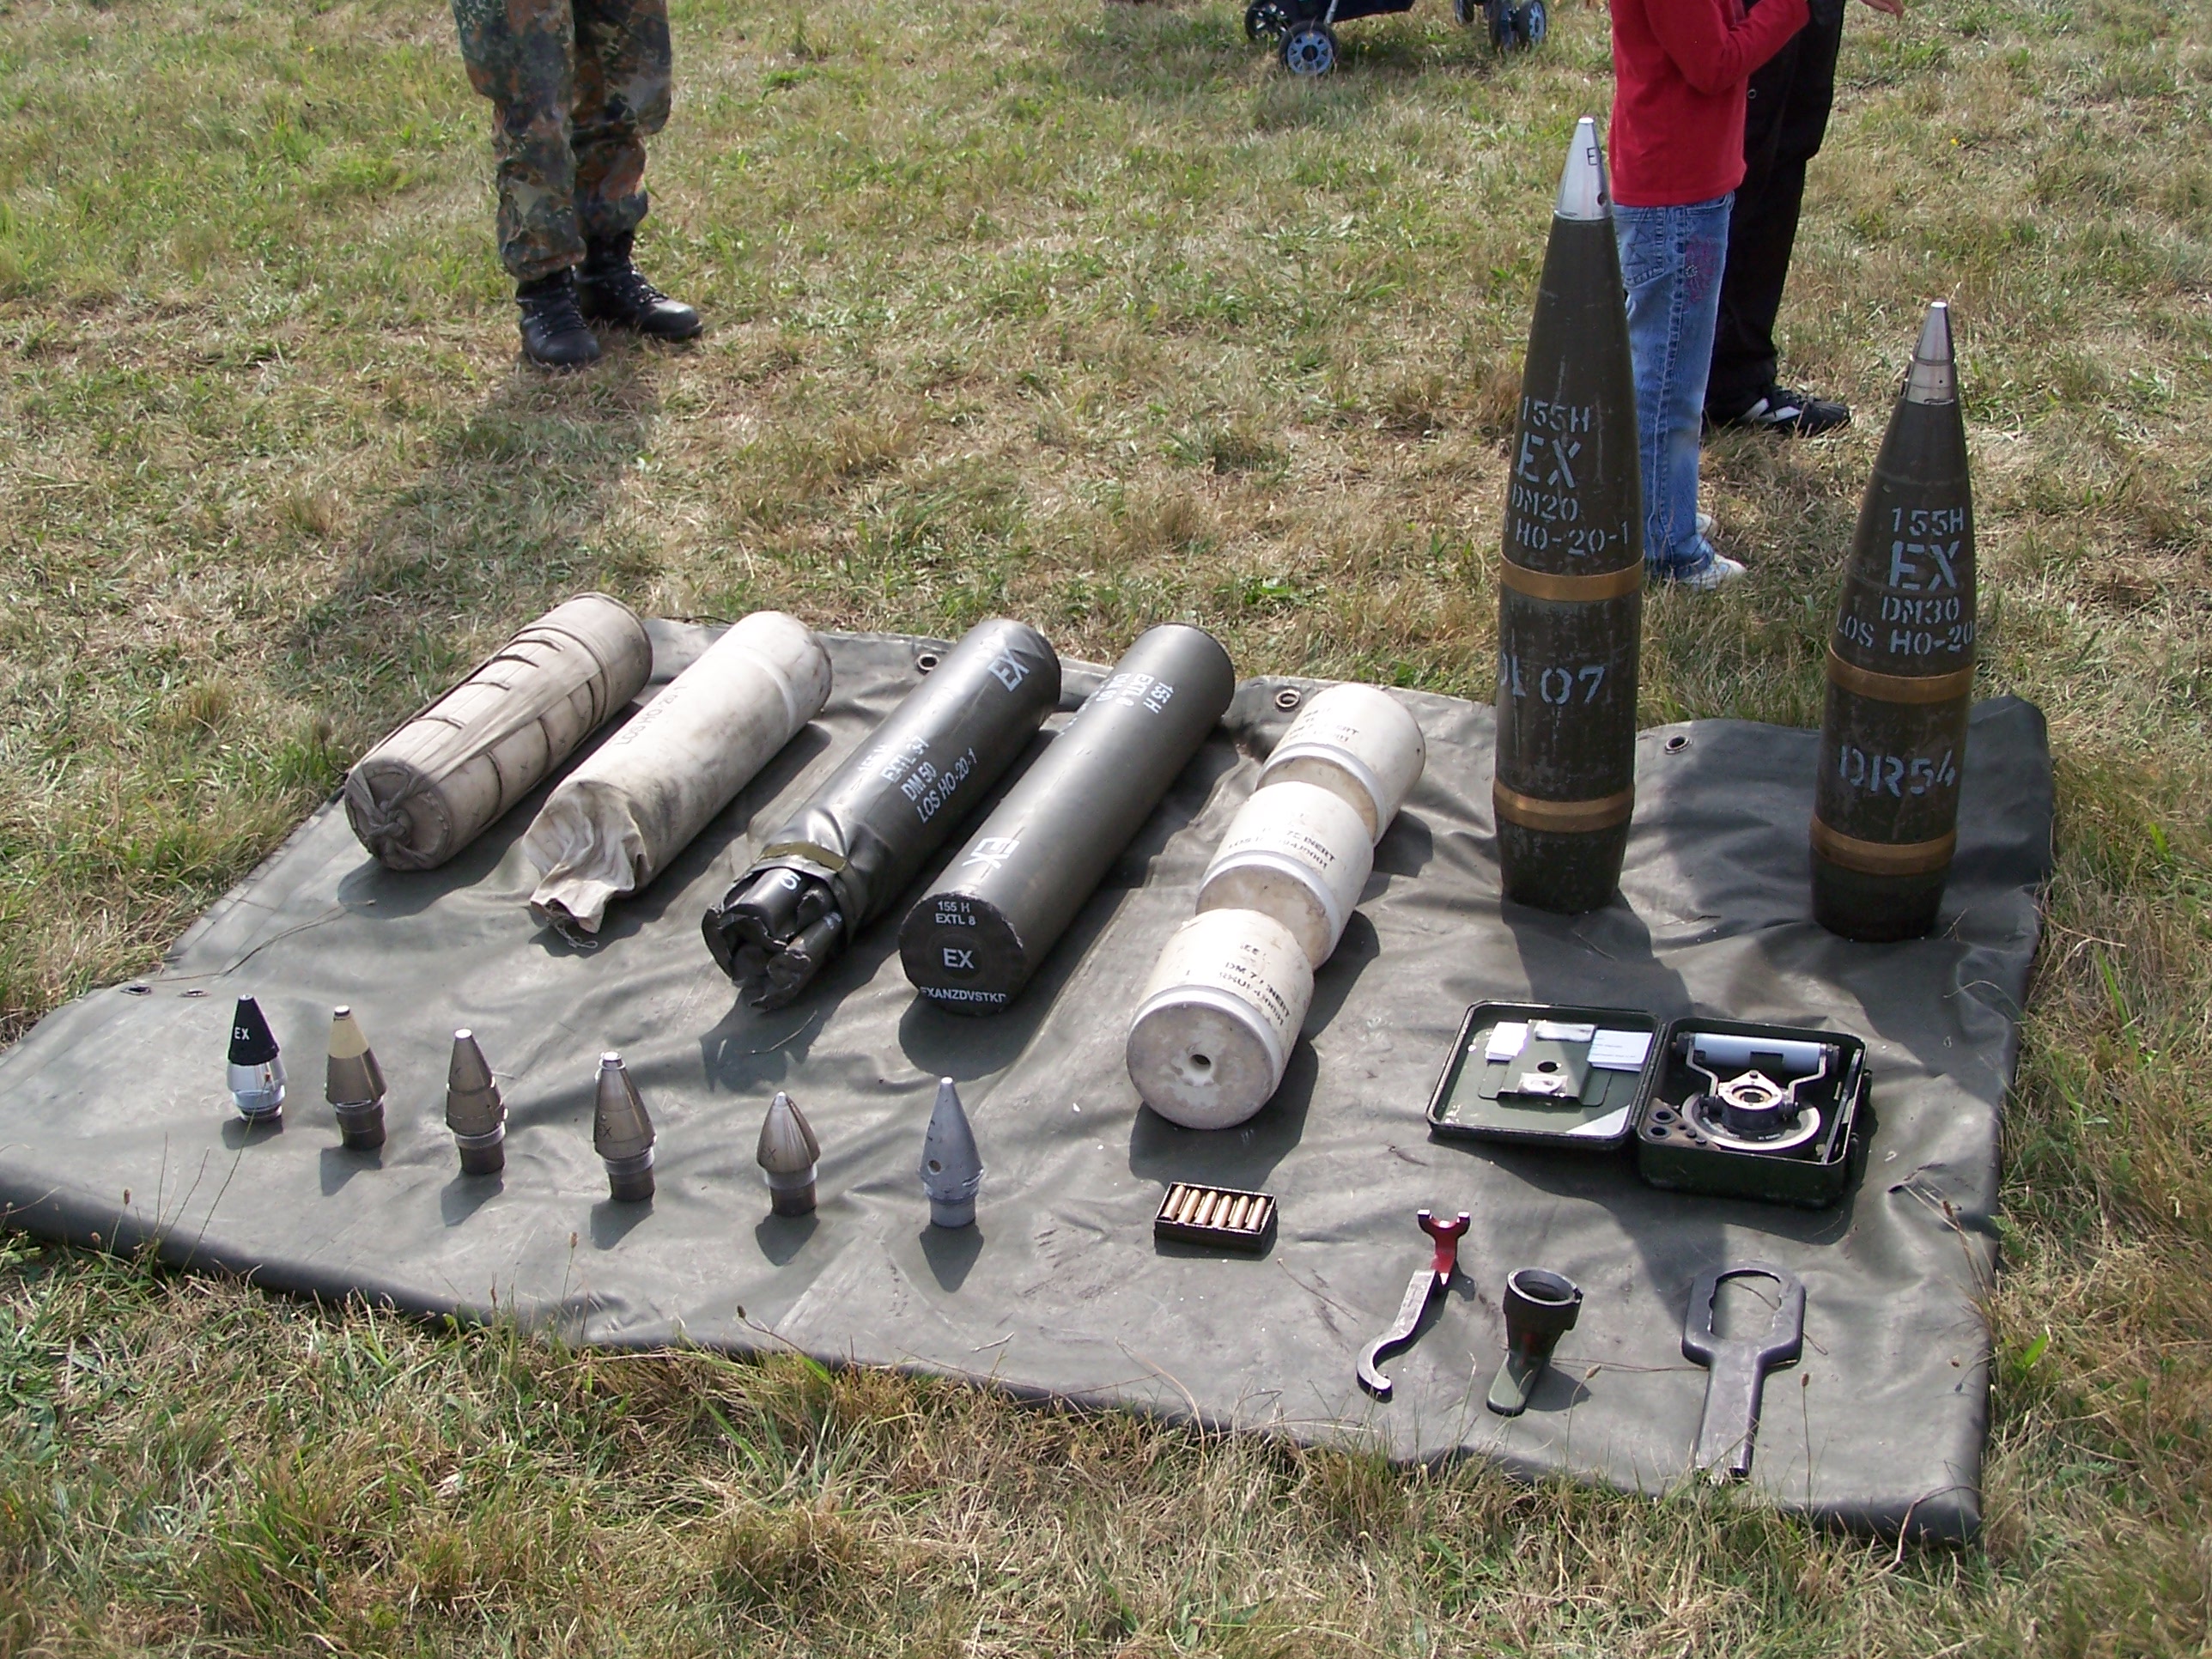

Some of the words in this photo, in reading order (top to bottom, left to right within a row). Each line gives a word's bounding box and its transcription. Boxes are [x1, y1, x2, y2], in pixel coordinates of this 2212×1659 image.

[1522, 395, 1589, 433] 155H
[1516, 430, 1582, 489] EX
[1511, 483, 1578, 522] DM20
[1892, 507, 1965, 537] 155H
[1889, 539, 1960, 592] EX
[1881, 596, 1960, 625] DM30
[987, 647, 1030, 692] EX
[1121, 672, 1155, 697] EXTL
[1143, 696, 1162, 714] H
[1151, 682, 1175, 704] 155
[900, 773, 927, 802] DM
[917, 761, 937, 783] 50
[916, 789, 941, 823] LOS
[962, 836, 1020, 869] EX
[934, 912, 966, 926] EXTL
[968, 915, 977, 927] 8
[937, 900, 957, 913] 155
[960, 902, 971, 914] H
[942, 946, 975, 969] EX
[233, 1026, 251, 1041] EX
